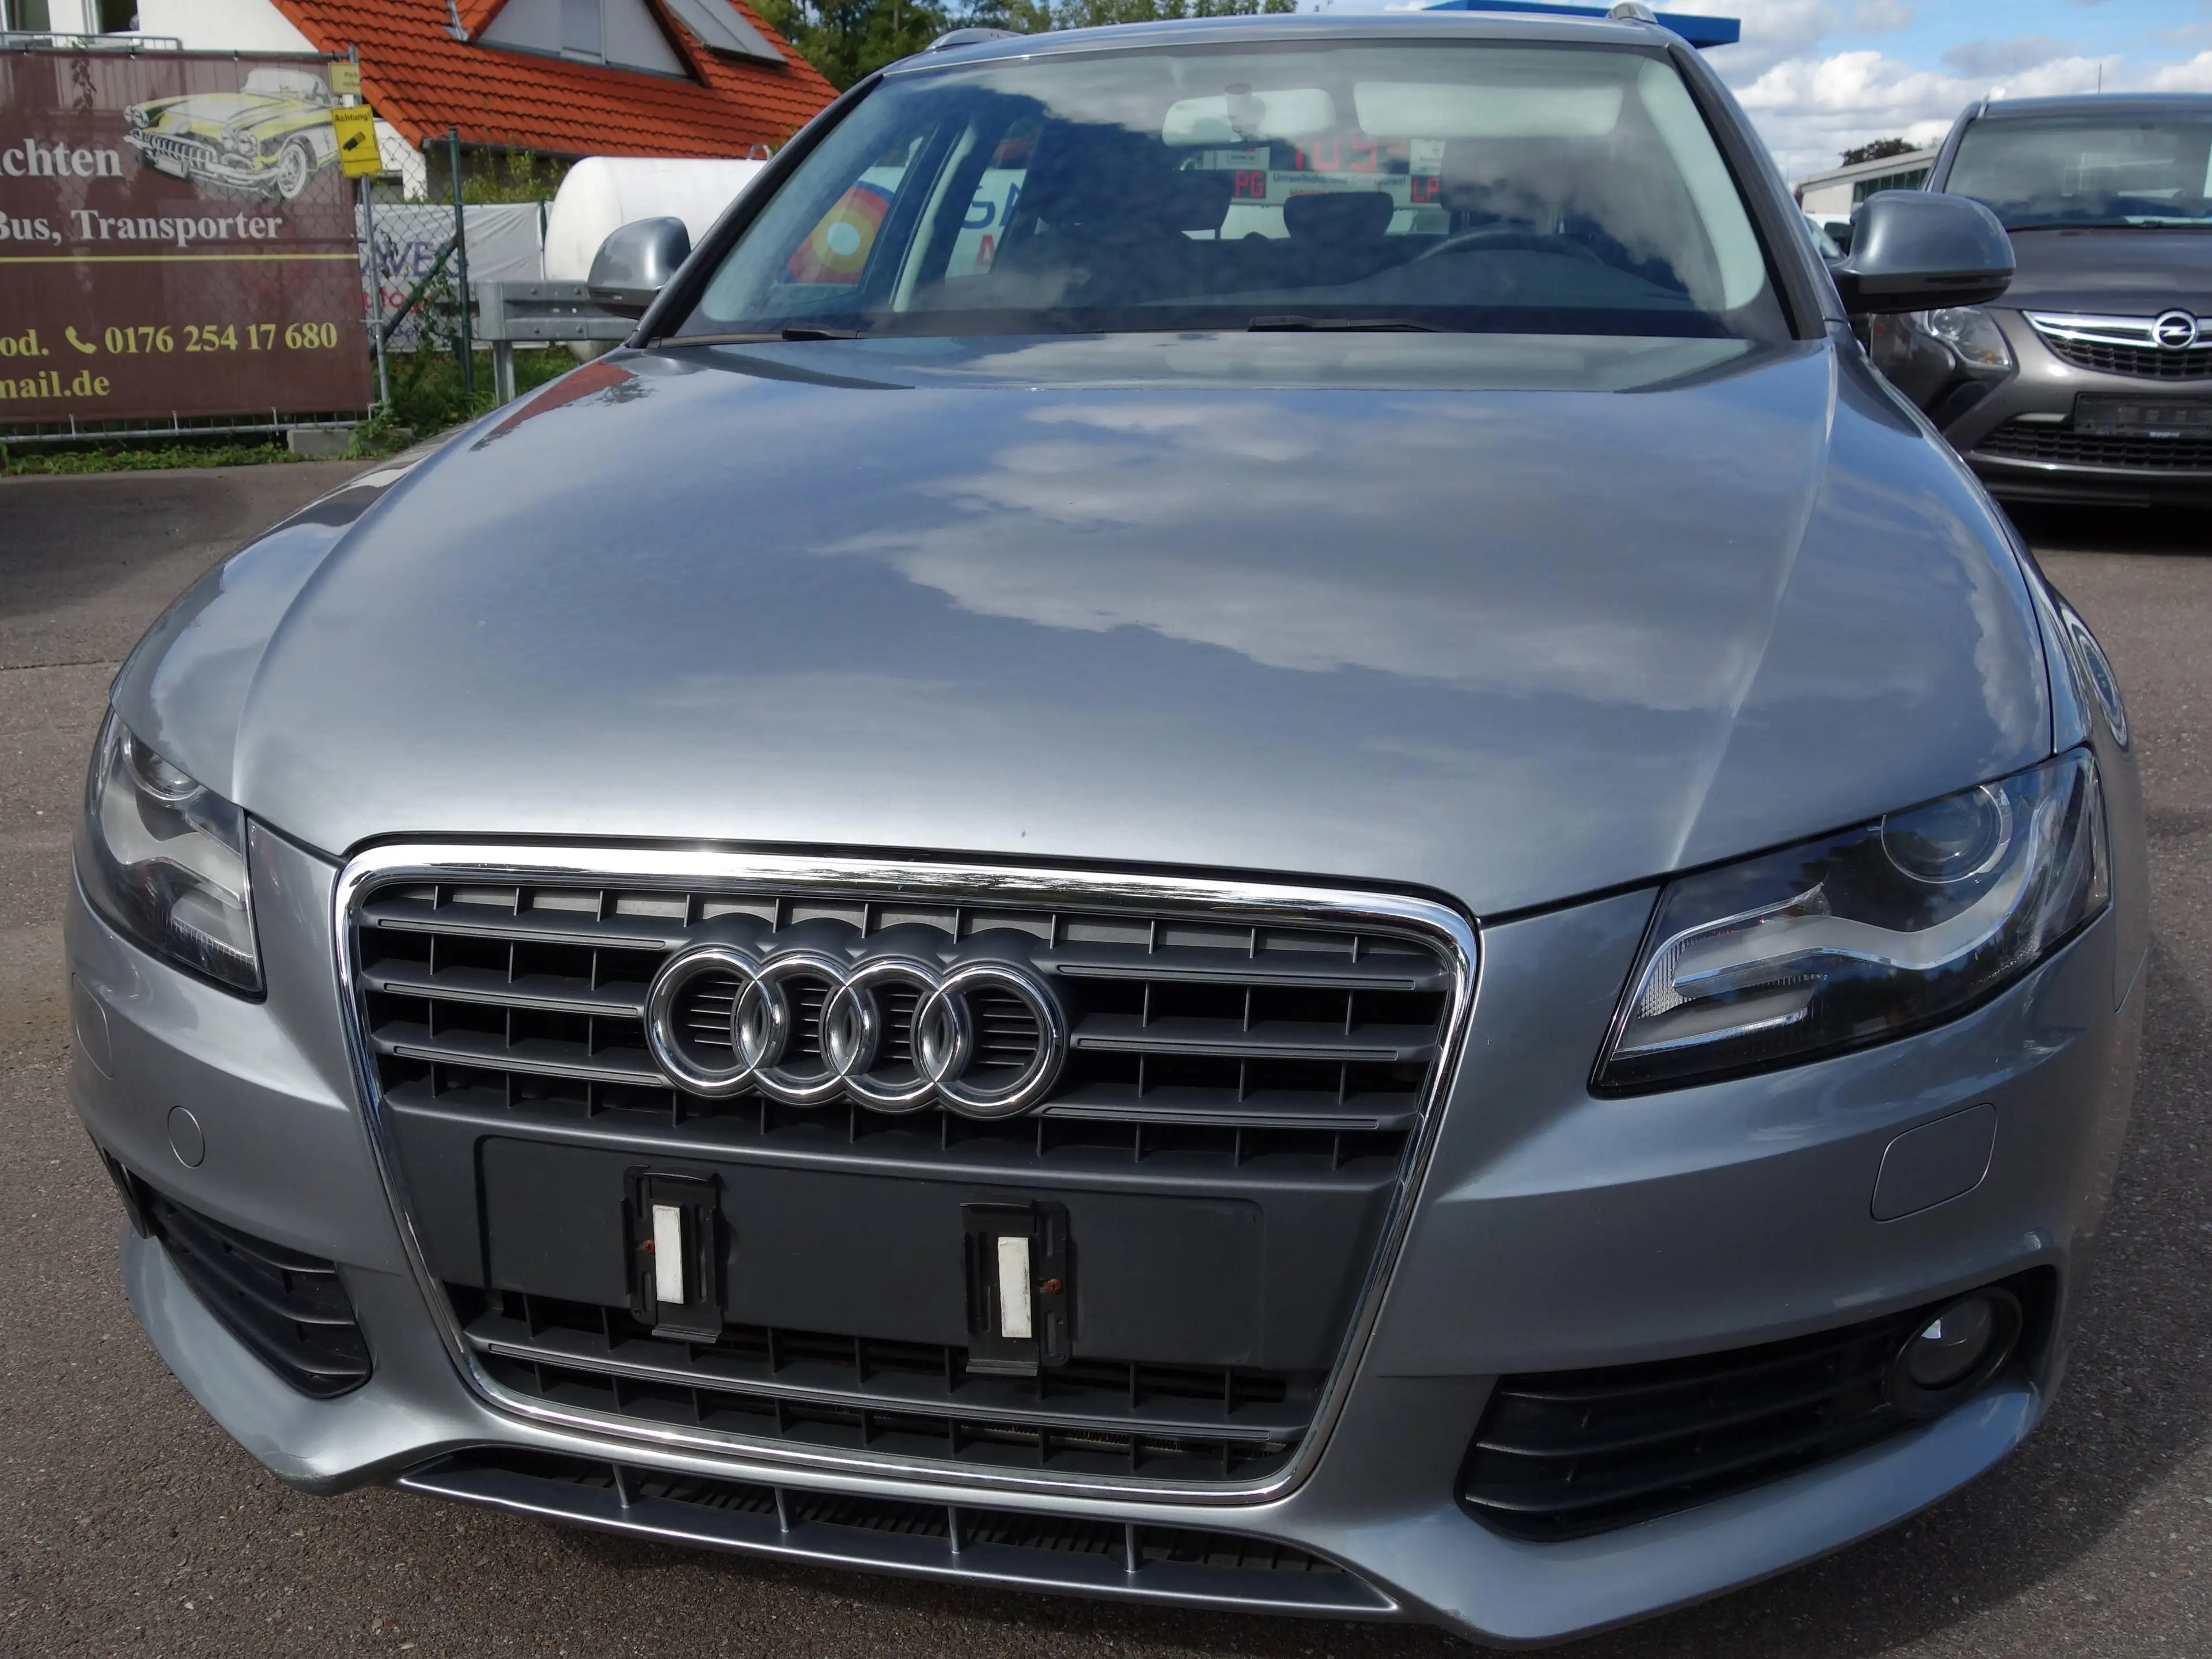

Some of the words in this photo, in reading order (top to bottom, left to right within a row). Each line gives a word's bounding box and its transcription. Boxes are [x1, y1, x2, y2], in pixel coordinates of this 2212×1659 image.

[335, 112, 370, 123] Achtung!
[0, 138, 123, 177] chten
[70, 209, 283, 248] Transporter
[105, 325, 173, 354] 0176
[183, 324, 238, 352] 254
[246, 324, 276, 350] 17
[285, 321, 338, 350] 680
